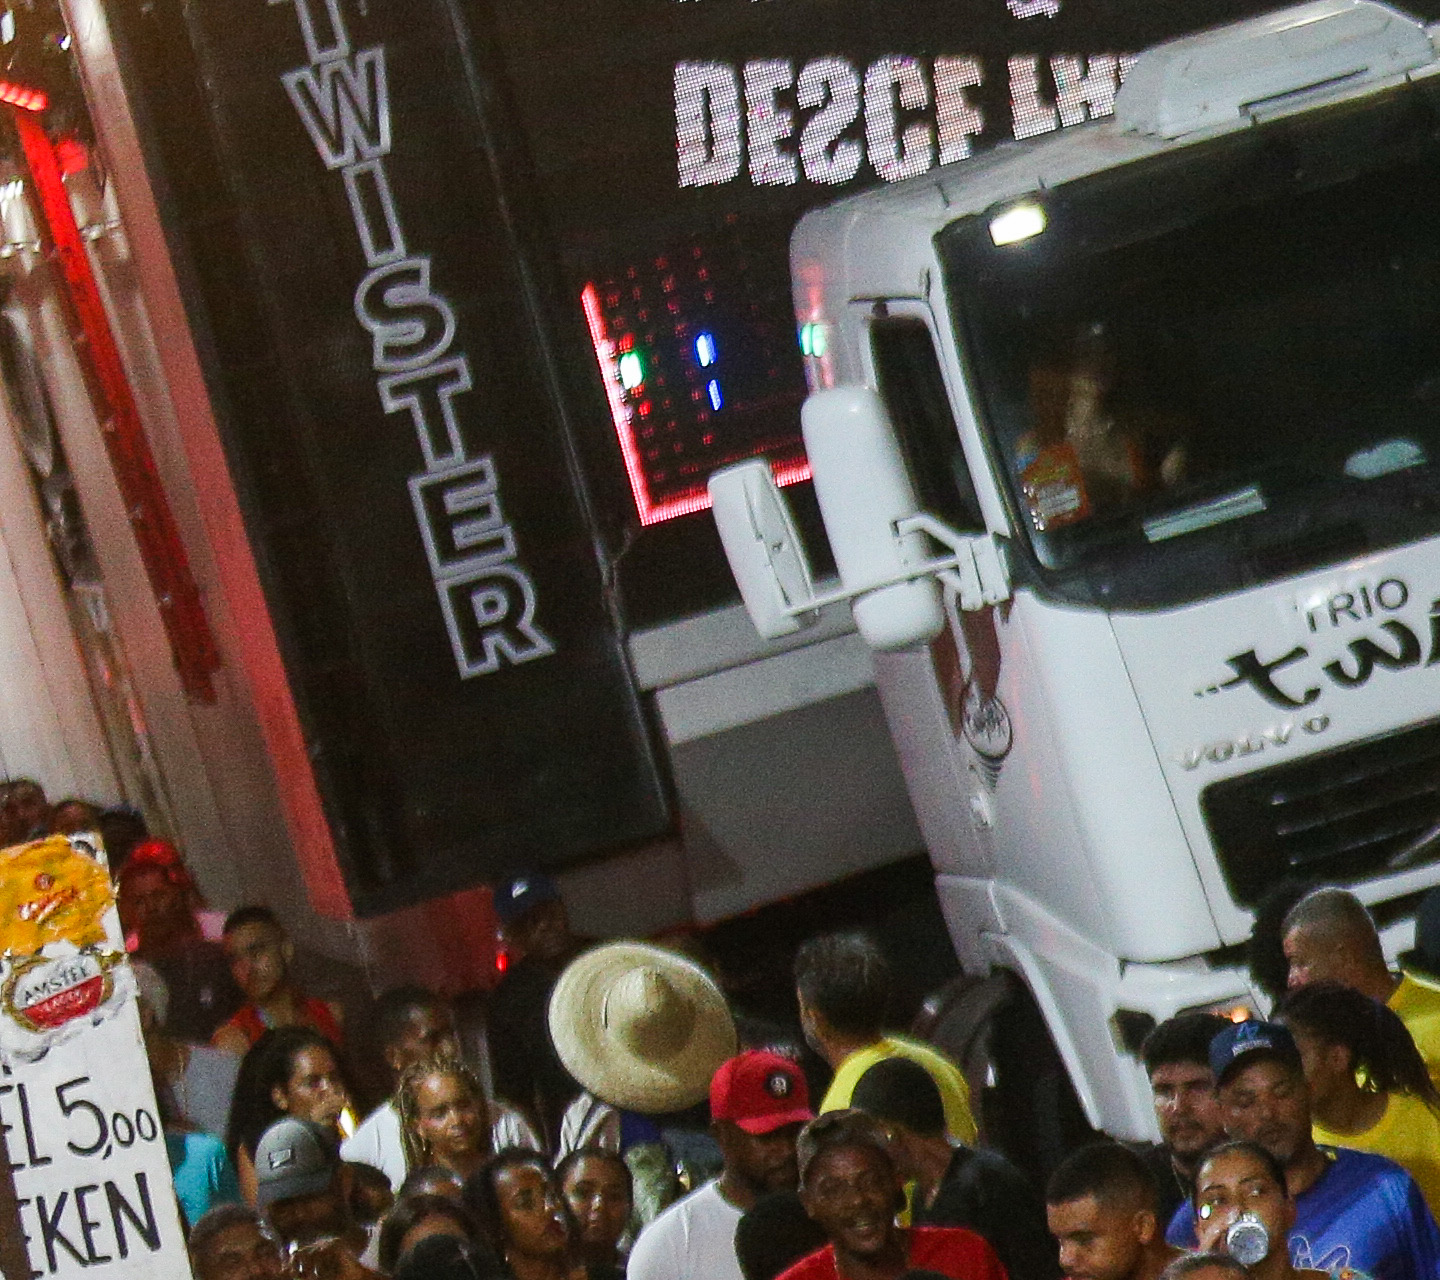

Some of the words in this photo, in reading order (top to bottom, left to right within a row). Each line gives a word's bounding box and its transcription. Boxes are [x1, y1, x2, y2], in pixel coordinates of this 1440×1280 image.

[1301, 577, 1410, 634] TRIO
[1180, 714, 1331, 771] VOLVO
[56, 1075, 159, 1162] 5,00
